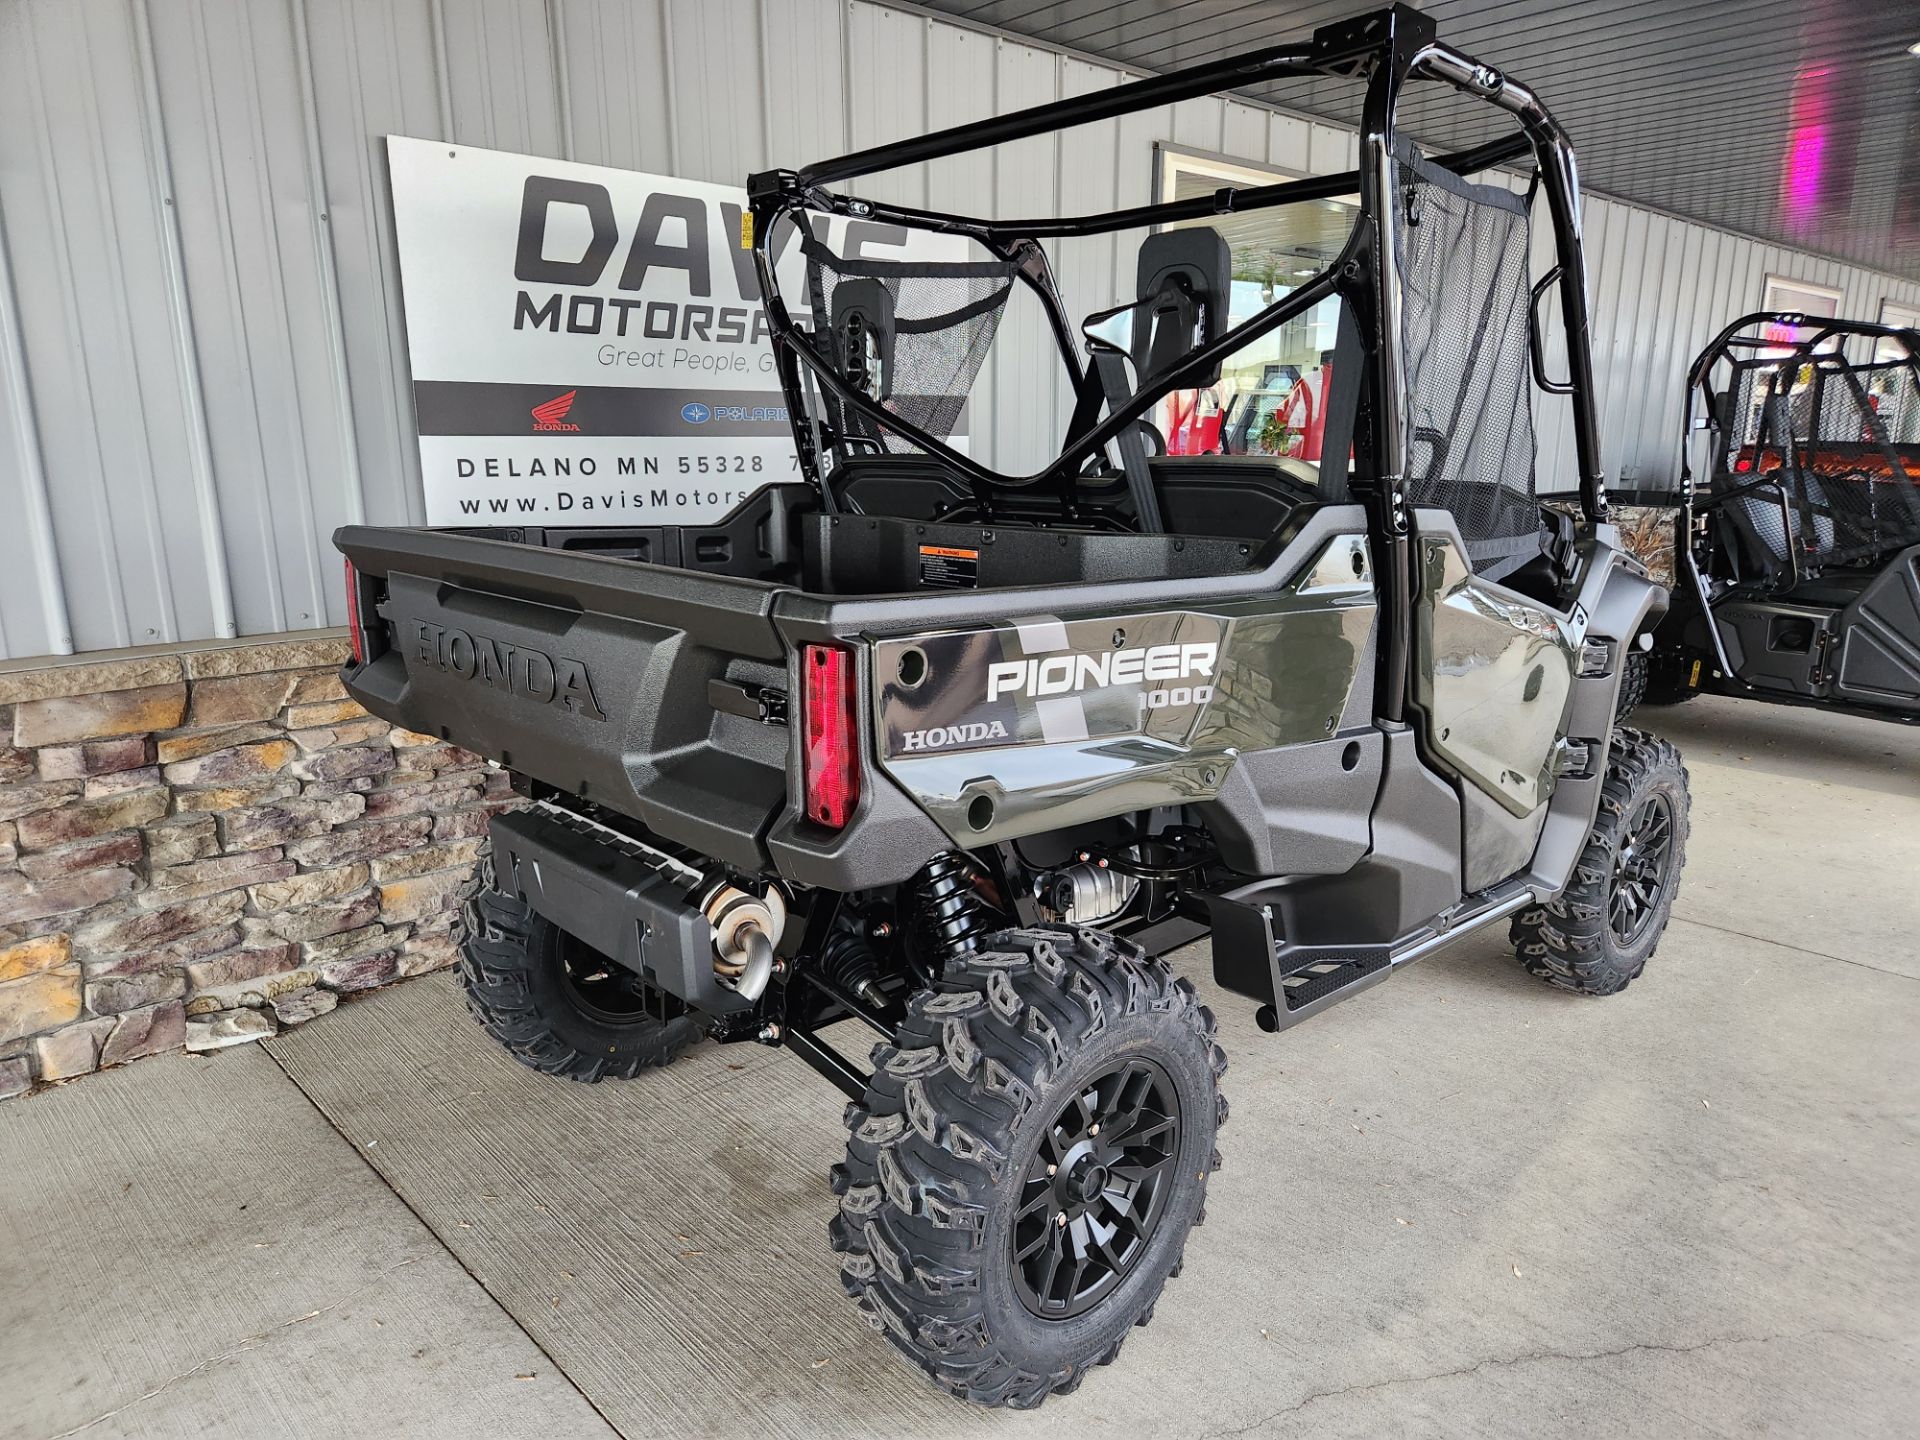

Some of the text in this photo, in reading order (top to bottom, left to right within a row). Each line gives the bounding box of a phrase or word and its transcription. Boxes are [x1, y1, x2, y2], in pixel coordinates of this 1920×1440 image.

[597, 344, 665, 368] Great
[673, 347, 750, 375] People,
[532, 423, 581, 432] HONDA
[456, 457, 597, 478] DELANO
[617, 456, 660, 475] MN
[677, 455, 763, 474] 55328
[411, 617, 608, 723] HONDA
[986, 641, 1218, 703] PIONEER
[1137, 684, 1214, 711] 1000
[902, 719, 1009, 752] HONDA
